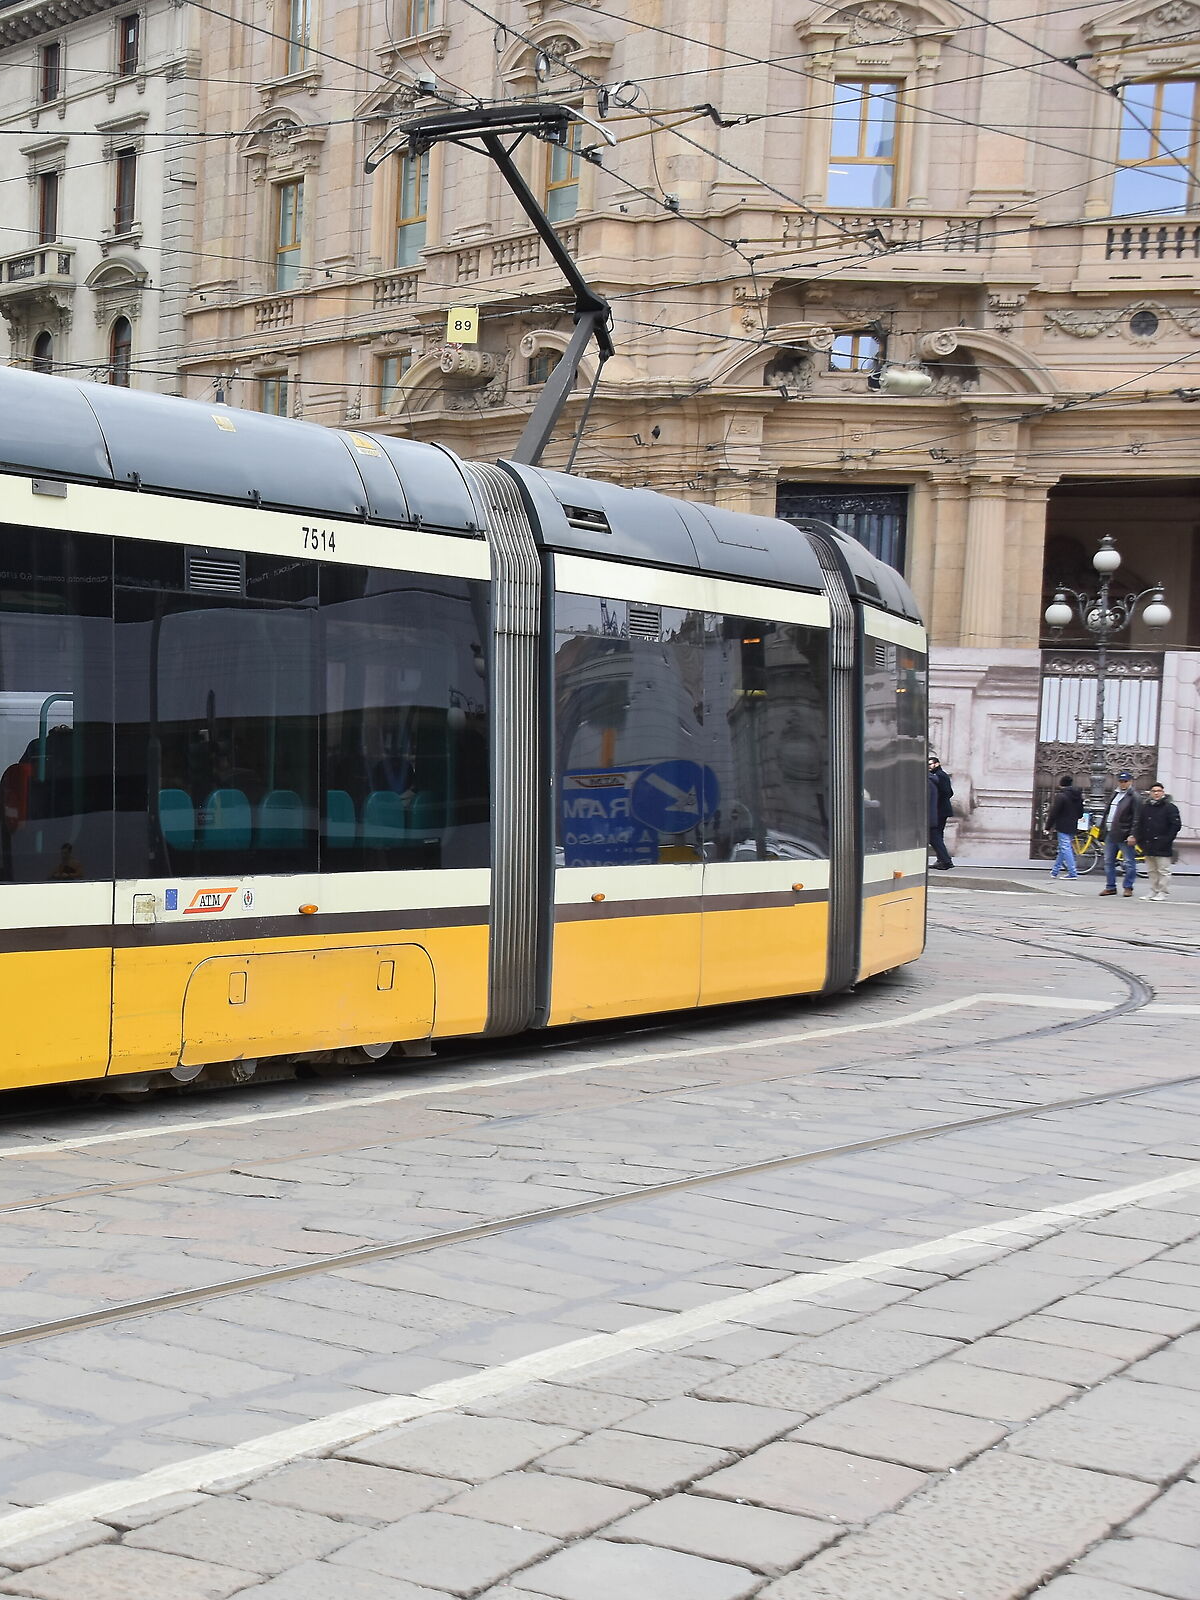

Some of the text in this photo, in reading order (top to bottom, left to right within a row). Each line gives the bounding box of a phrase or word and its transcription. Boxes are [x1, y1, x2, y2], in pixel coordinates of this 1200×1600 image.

[454, 320, 472, 331] 89
[302, 526, 335, 552] 7514
[200, 894, 221, 907] ATM
